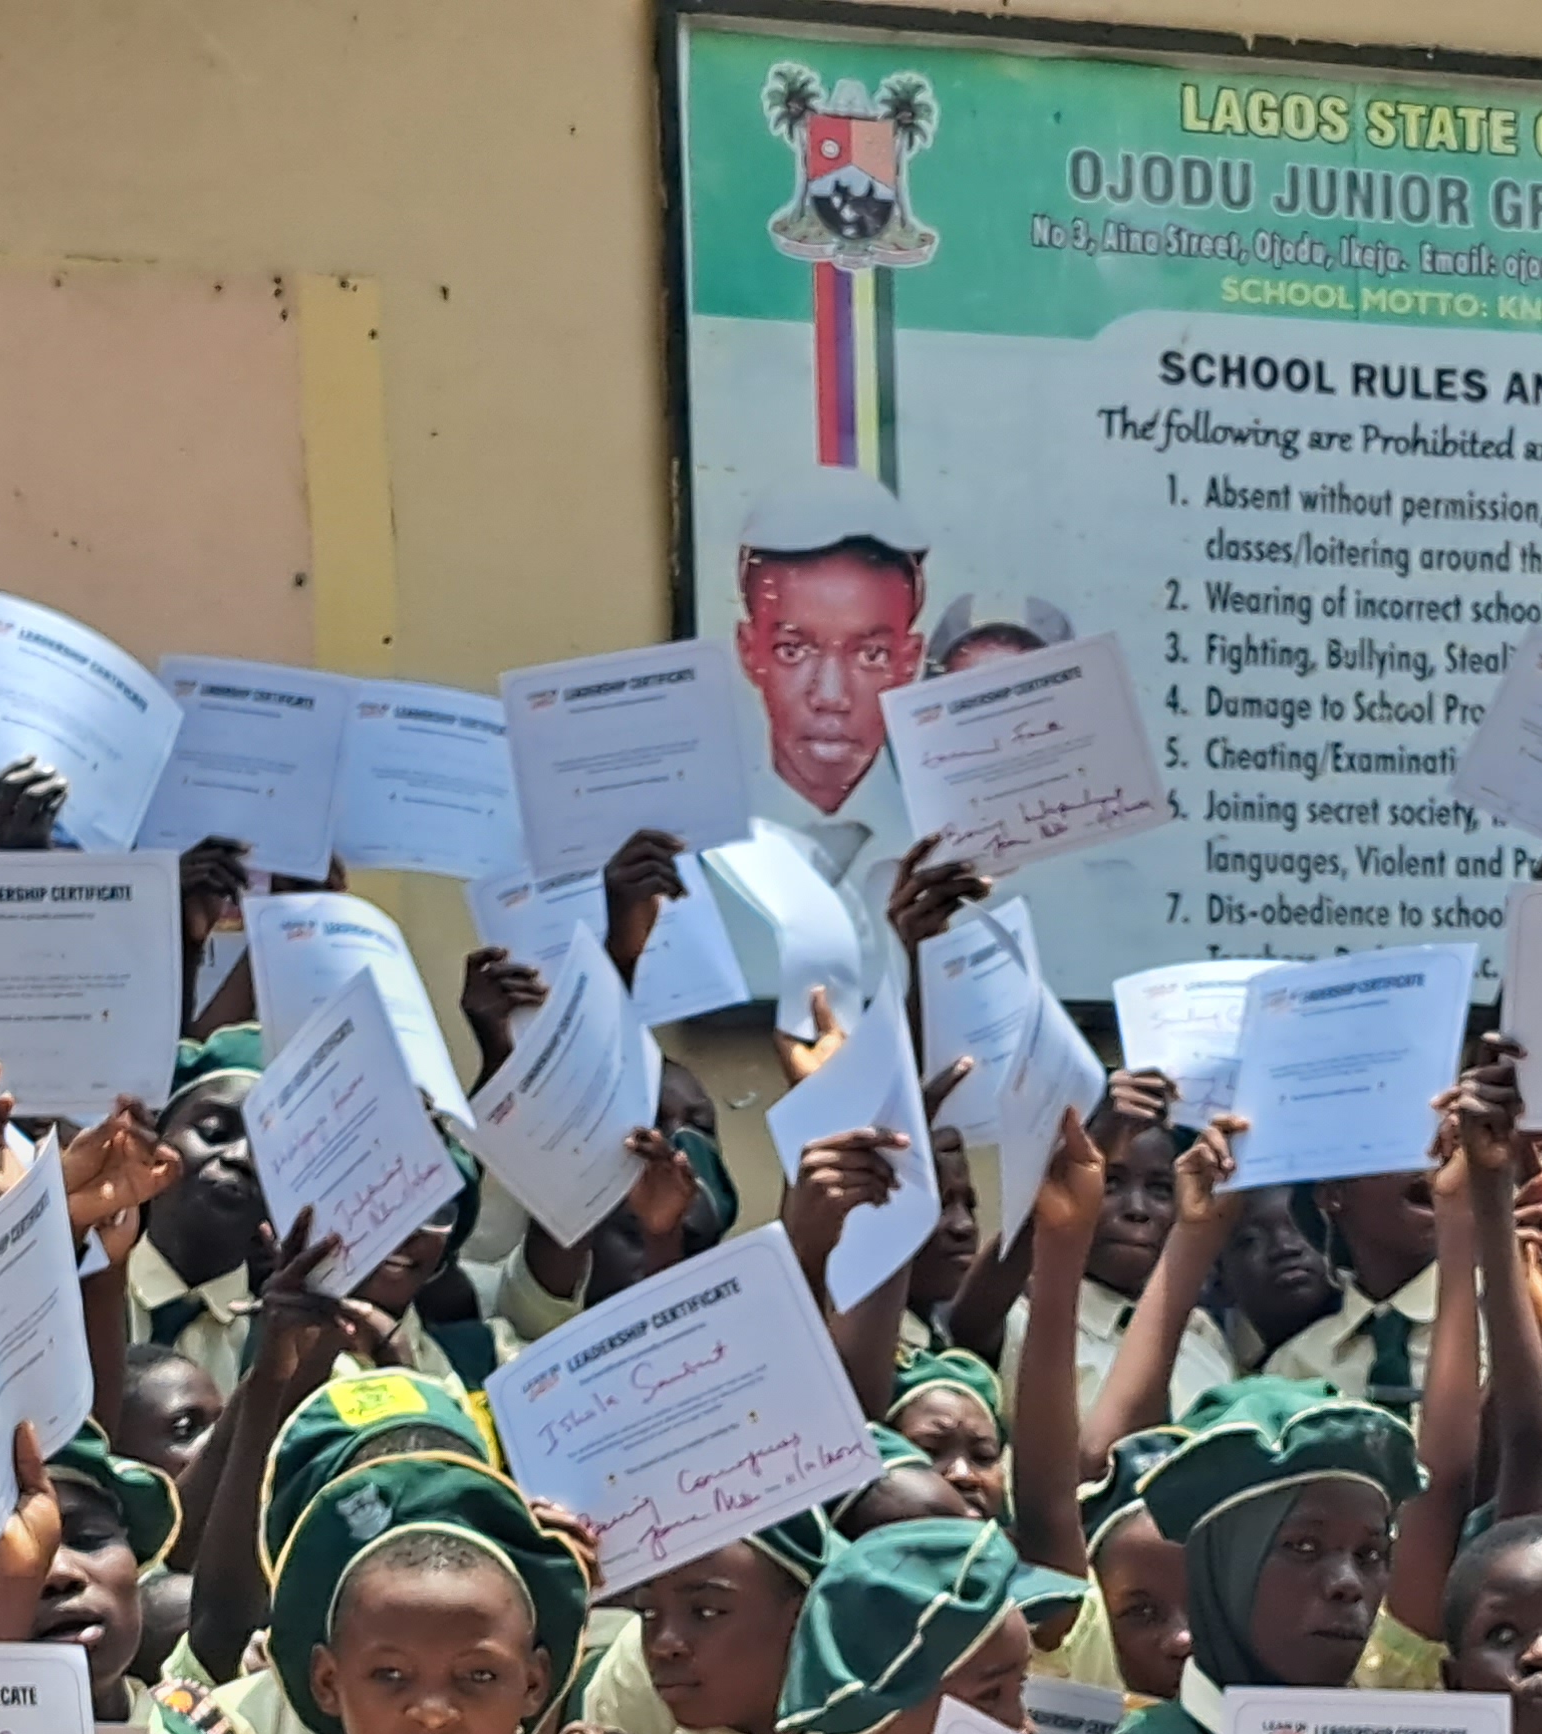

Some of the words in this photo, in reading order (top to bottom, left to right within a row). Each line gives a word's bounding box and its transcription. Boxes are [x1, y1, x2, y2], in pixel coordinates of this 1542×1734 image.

[1181, 84, 1349, 143] LAGOS
[1365, 101, 1519, 155] STATE
[1067, 148, 1253, 211] OJODU
[1274, 162, 1470, 226] JUNIOR
[1101, 222, 1157, 255] Aina
[1165, 225, 1248, 266] Street,
[1254, 231, 1333, 270] Ojodu,
[1340, 234, 1408, 277] Ikeja.
[1420, 241, 1498, 278] Email:
[1220, 276, 1353, 312] SCHOOL
[1362, 287, 1488, 318] MOTTO:
[1160, 352, 1335, 395] SCHOOL
[1352, 363, 1488, 401] RULES
[1098, 406, 1156, 441] The
[1159, 408, 1300, 460] following
[1307, 429, 1353, 453] are
[1361, 424, 1515, 461] Prohibited
[1165, 474, 1188, 507] 1.
[1205, 474, 1291, 511] Absent
[1299, 481, 1393, 516] without
[1205, 527, 1409, 578] classes/loitering
[1420, 539, 1511, 576] around
[1165, 580, 1189, 612] 2.
[1205, 582, 1312, 625] Wearing
[1321, 583, 1348, 619] of
[1354, 584, 1462, 623] incorrect
[1164, 633, 1189, 665] 3.
[1205, 634, 1317, 676] Fighting,
[1327, 638, 1436, 681] Bullying,
[50, 885, 132, 901] CERTIFICATE
[566, 1322, 648, 1373] LEADERSHIP
[651, 1278, 742, 1330] CERTIFICATE
